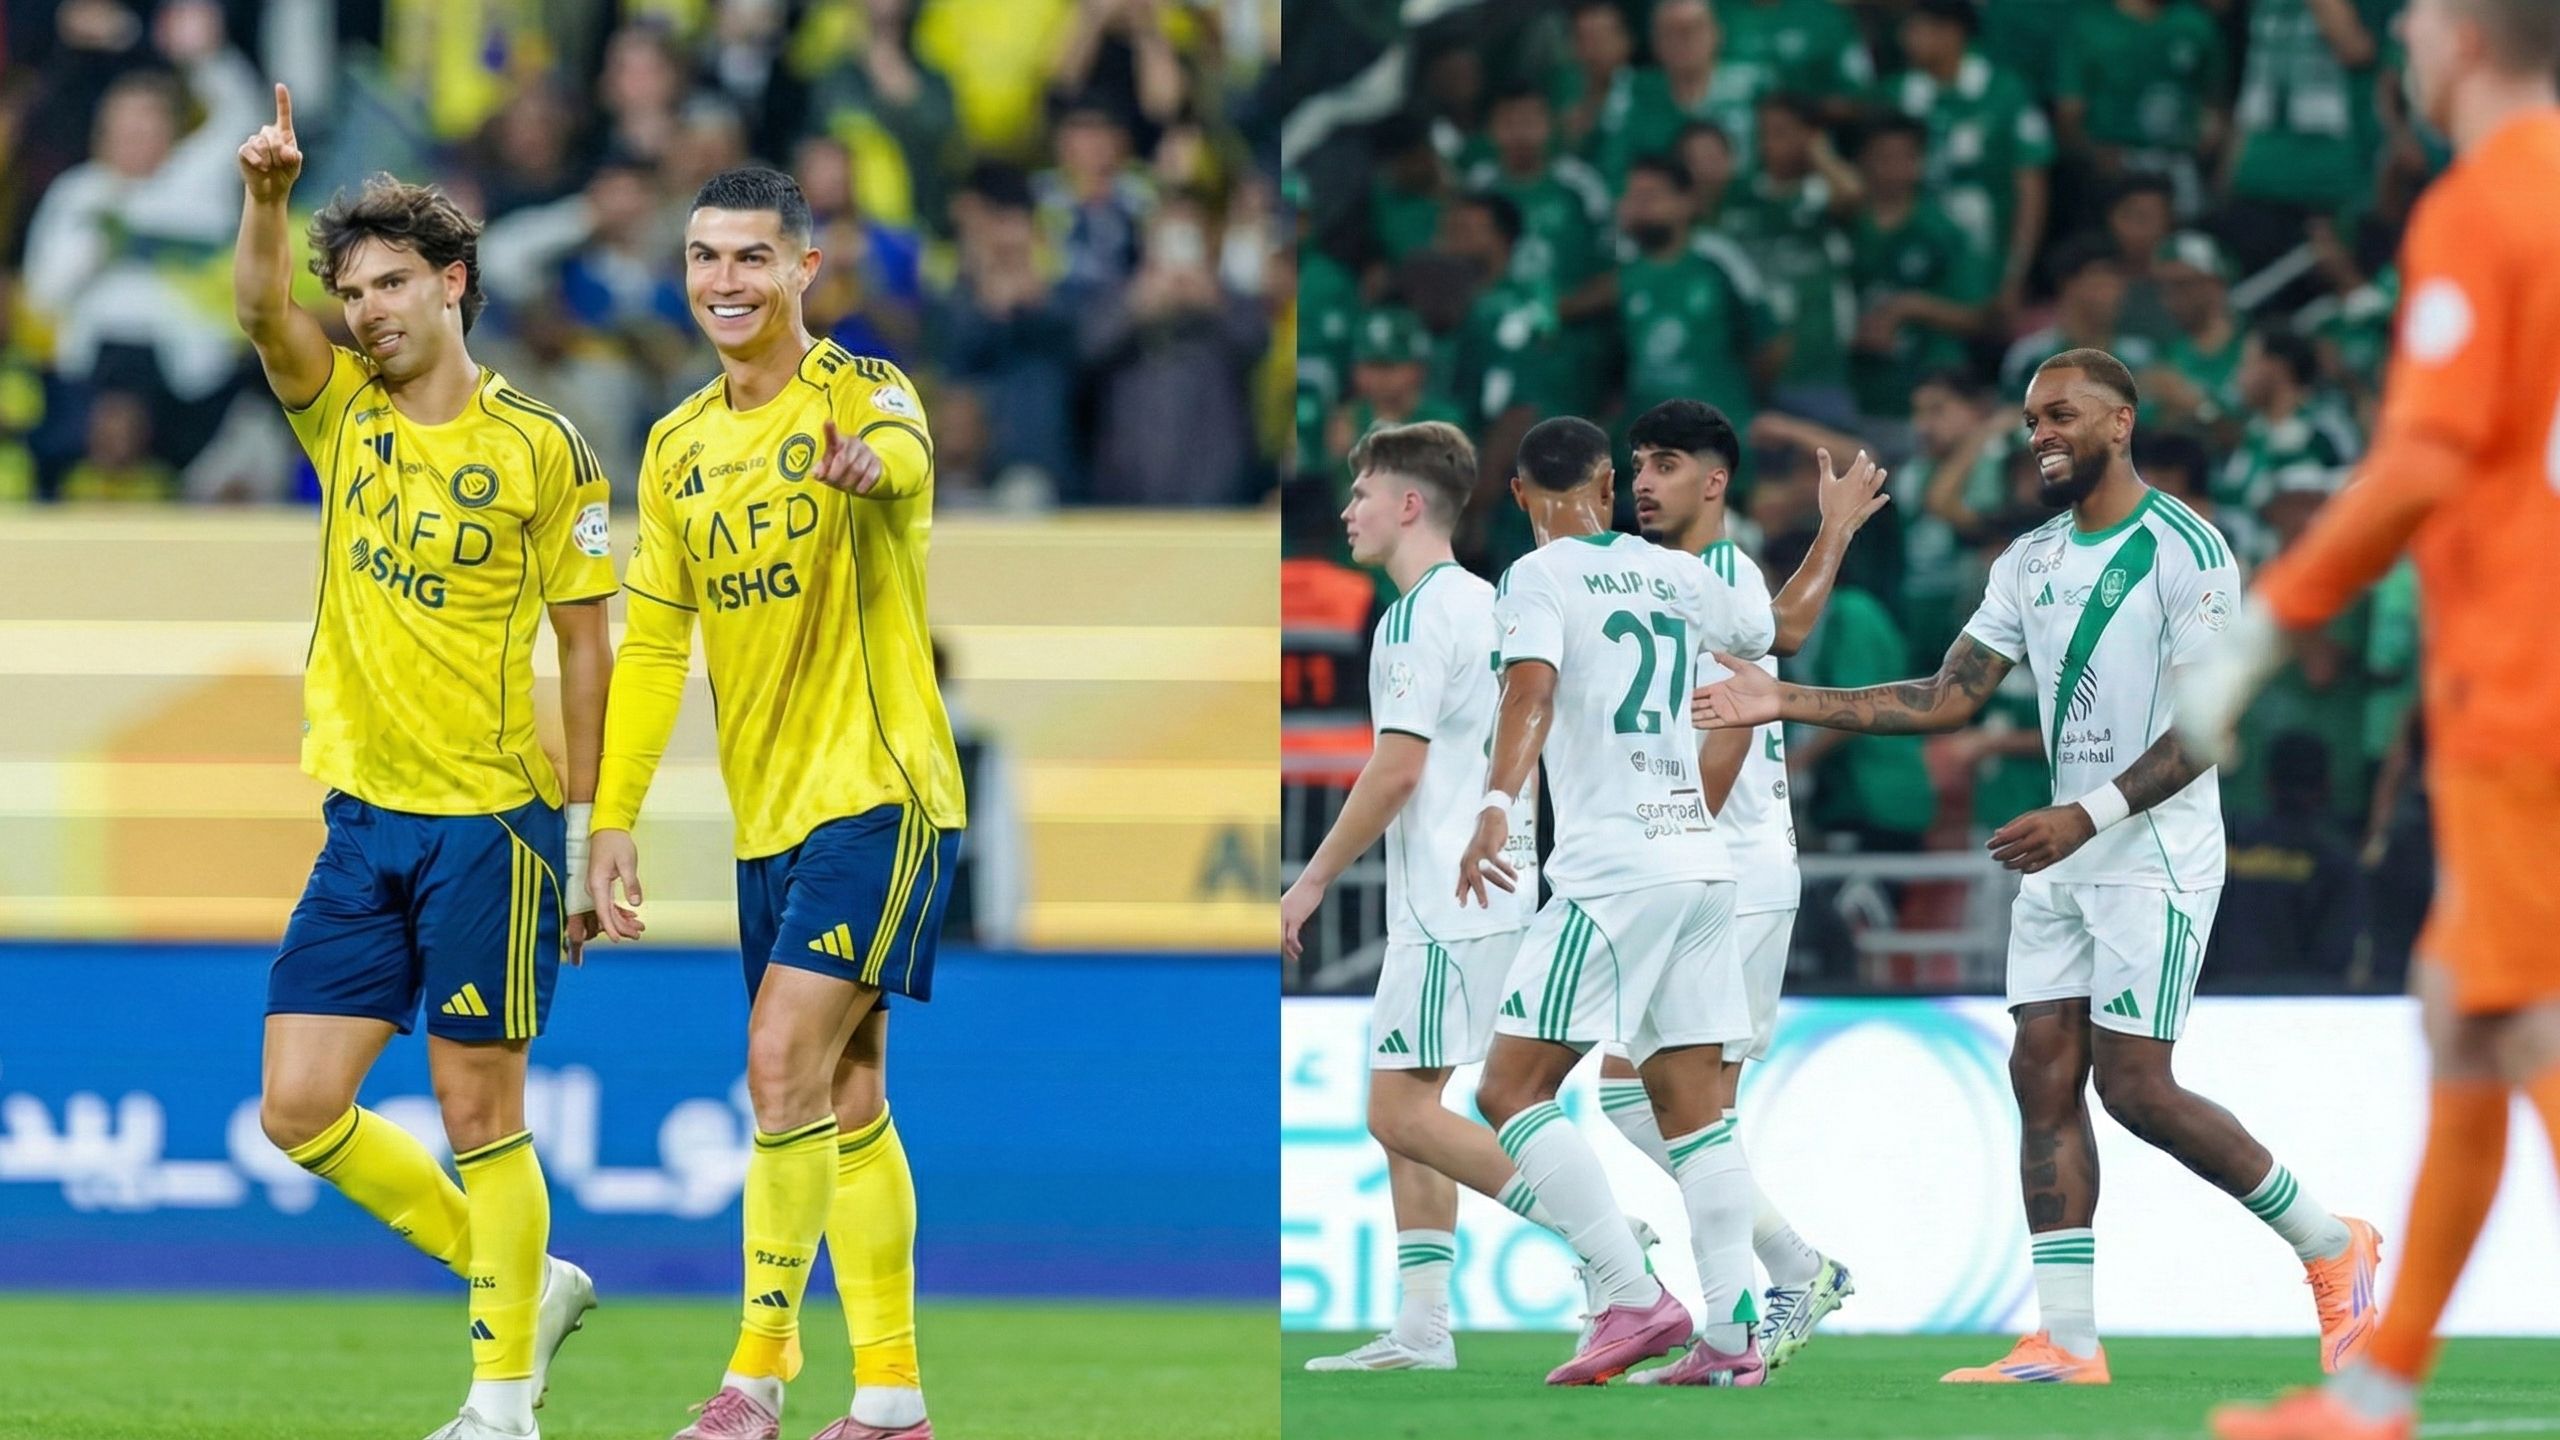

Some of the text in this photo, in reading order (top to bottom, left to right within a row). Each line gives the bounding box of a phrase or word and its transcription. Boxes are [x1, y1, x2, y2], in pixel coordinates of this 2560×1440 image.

[346, 465, 494, 566] KAFD
[370, 547, 447, 609] SHG
[719, 561, 801, 611] SHG
[1601, 609, 1688, 735] 27
